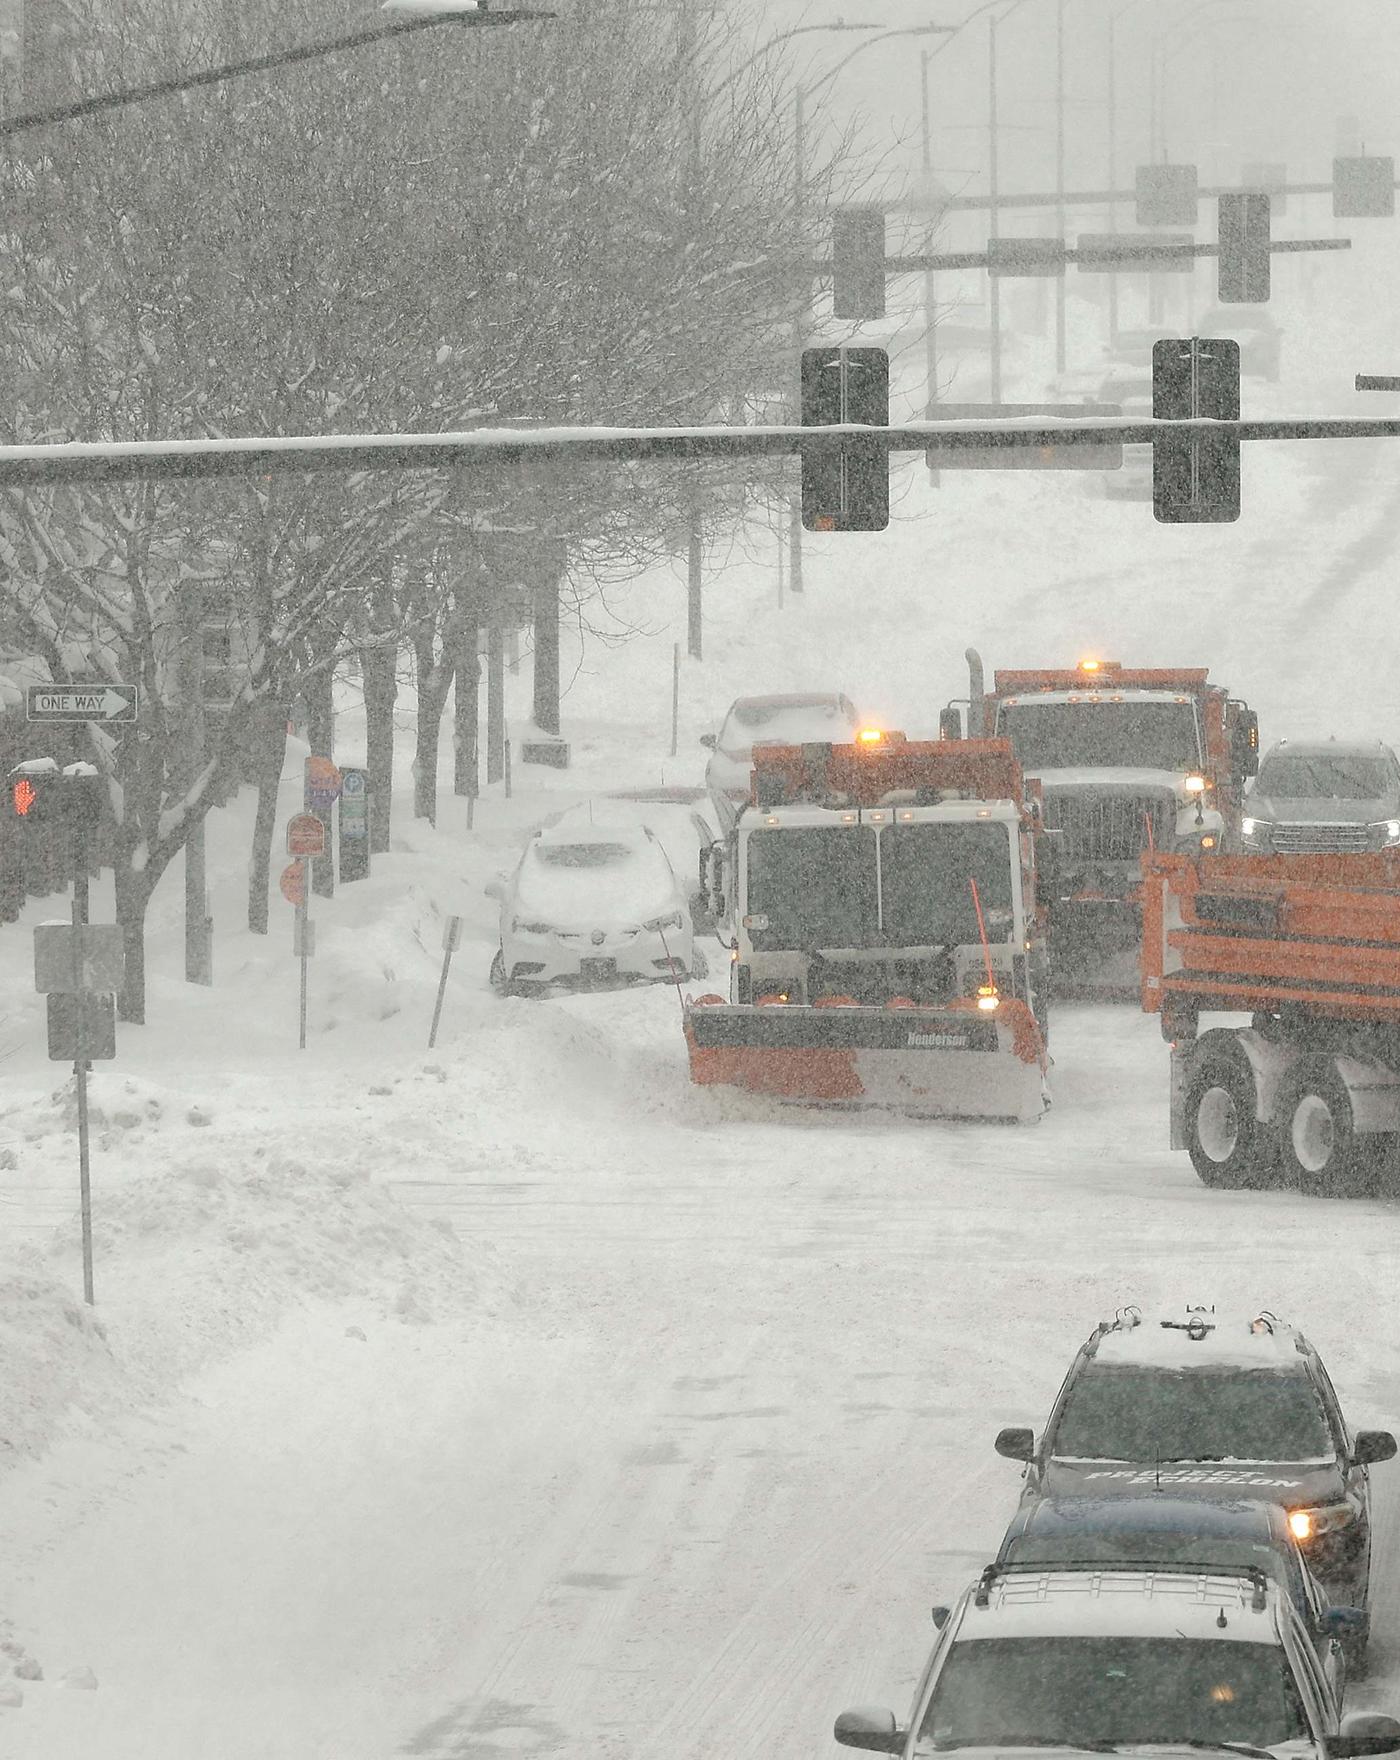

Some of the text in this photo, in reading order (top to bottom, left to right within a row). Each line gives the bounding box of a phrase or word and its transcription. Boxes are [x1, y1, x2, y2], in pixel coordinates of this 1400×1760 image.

[40, 696, 105, 711] ONE WAY
[907, 1031, 968, 1046] Henderson
[1084, 1470, 1265, 1480] PROJECT
[1127, 1476, 1303, 1487] ECHELON
